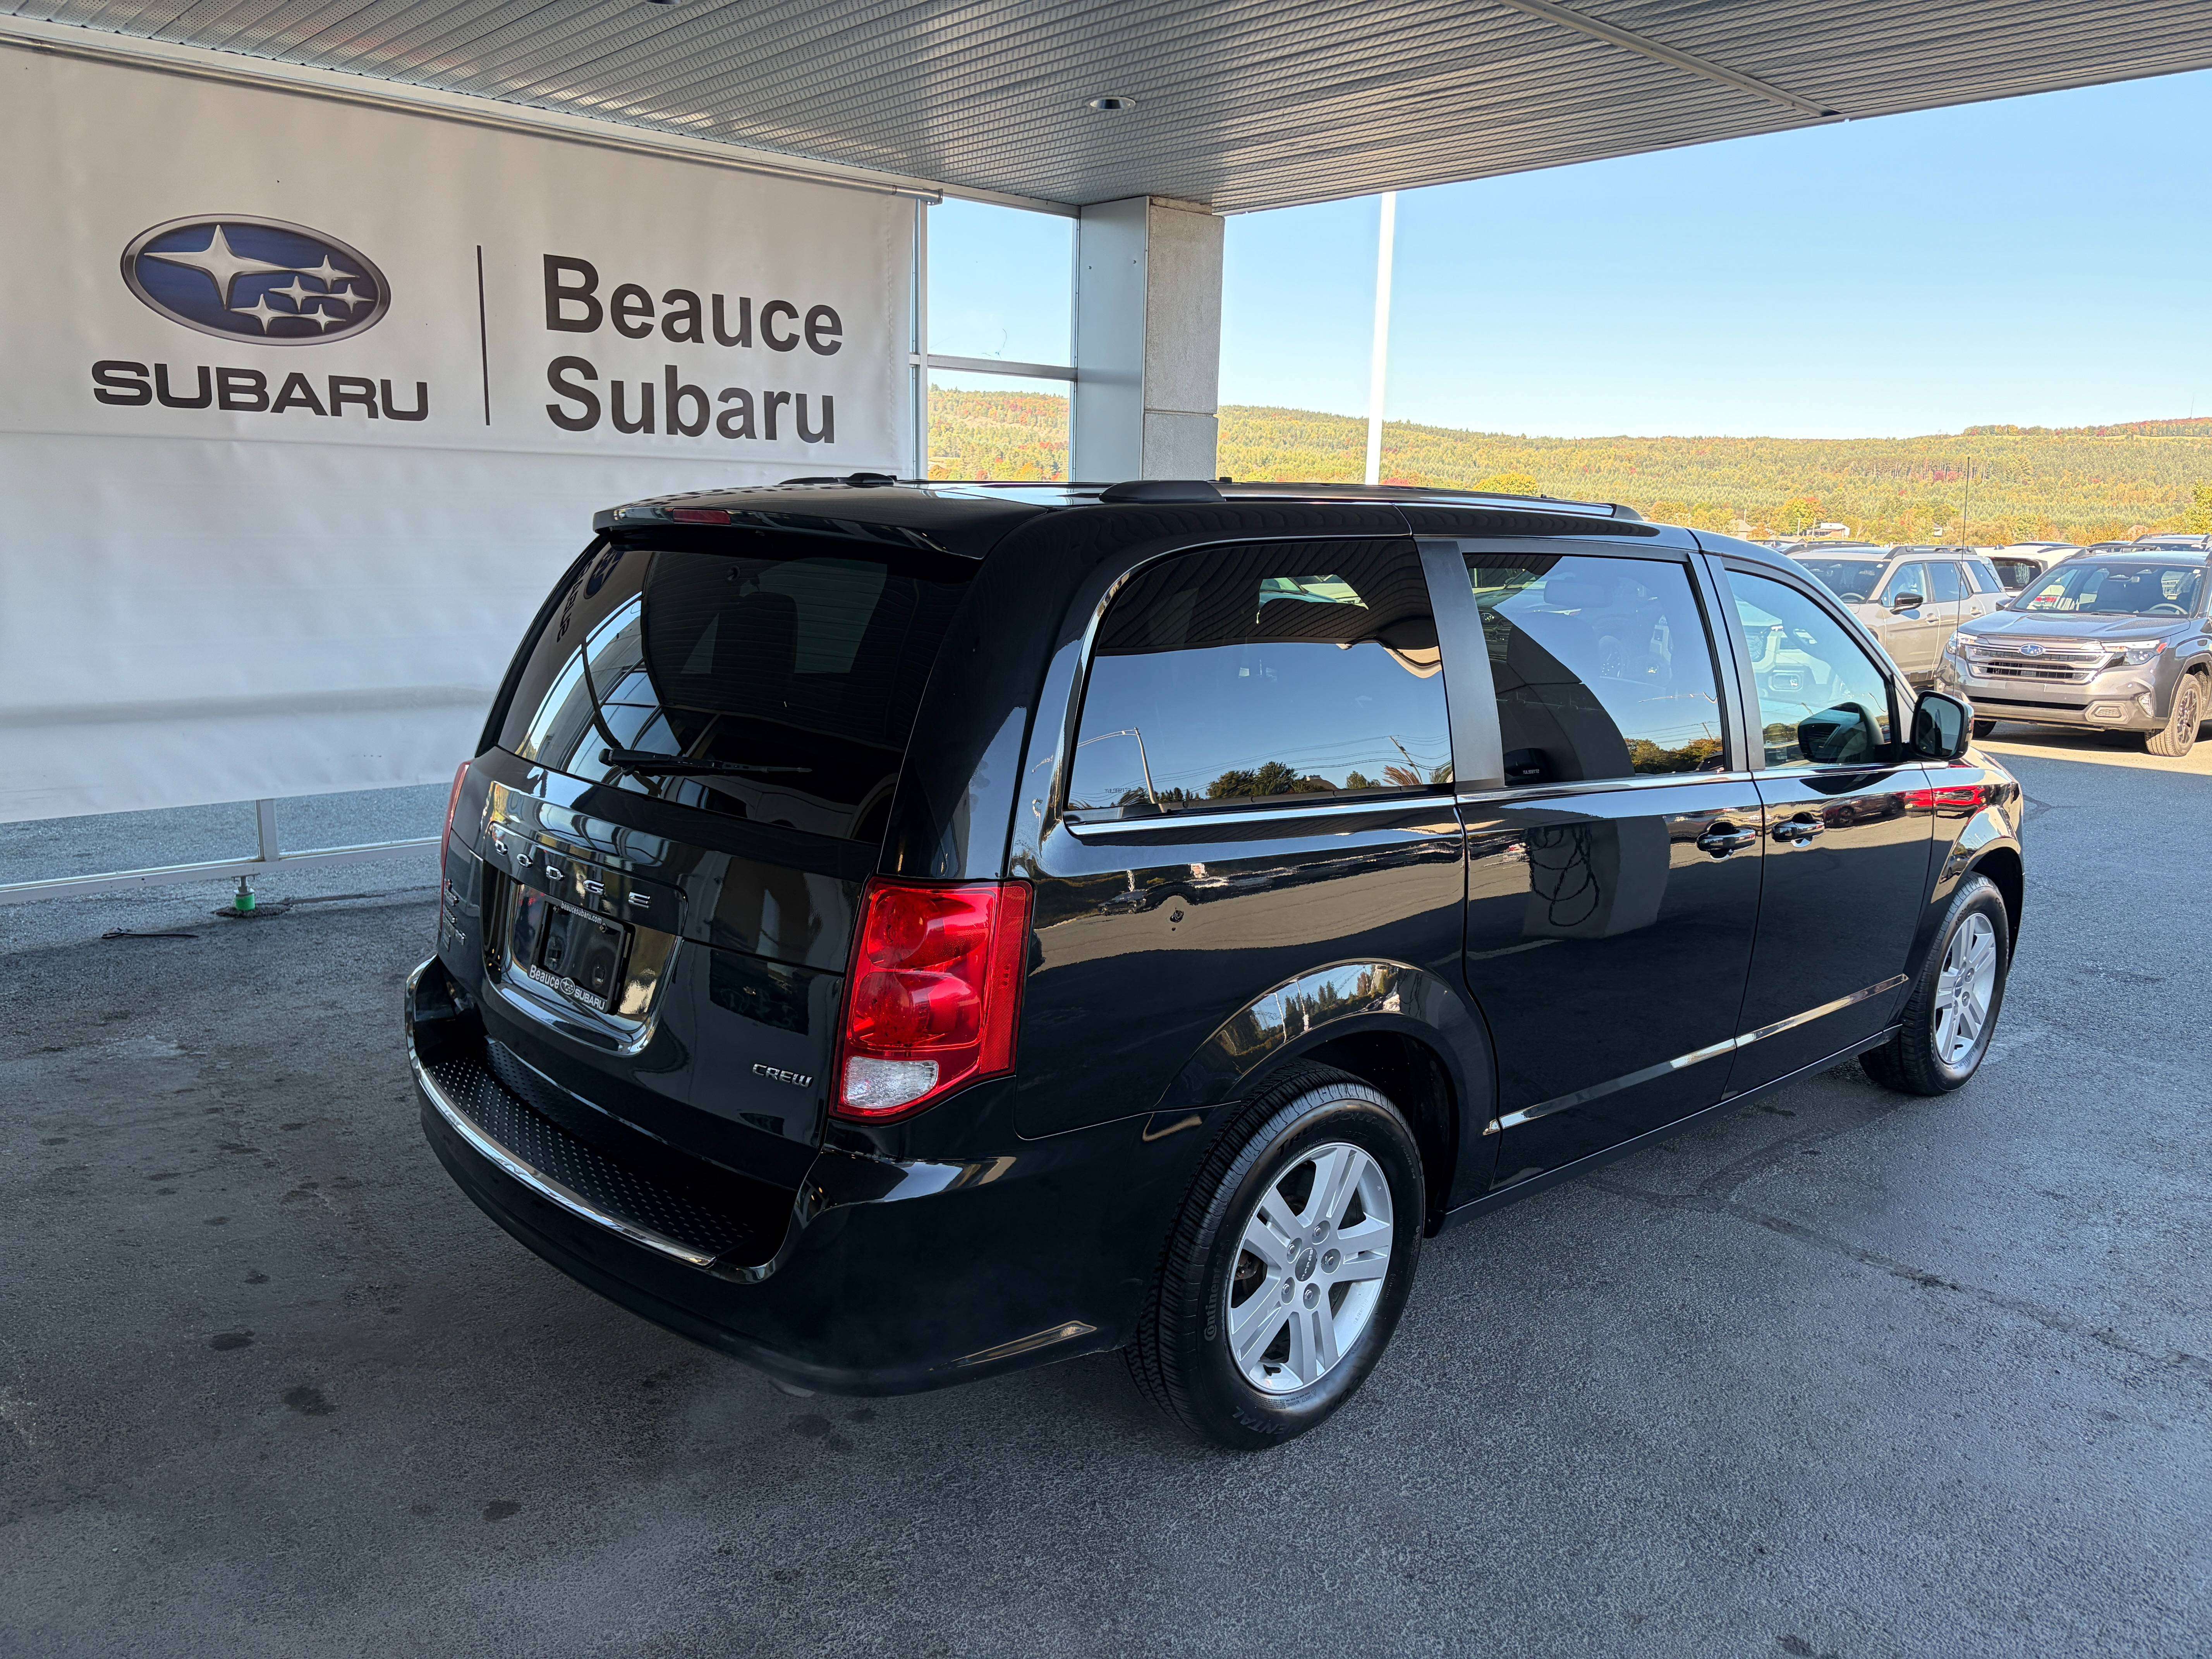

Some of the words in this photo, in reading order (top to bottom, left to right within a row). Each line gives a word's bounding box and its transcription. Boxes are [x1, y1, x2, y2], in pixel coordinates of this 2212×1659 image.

[543, 254, 843, 356] Beauce
[91, 360, 428, 422] SUBARU
[545, 356, 835, 444] Subaru
[495, 839, 651, 909] DODGE
[561, 901, 602, 924] beaucesubaru.com
[529, 964, 560, 989] Beauce
[574, 988, 605, 1010] SUBARU
[752, 1063, 814, 1087] CREW
